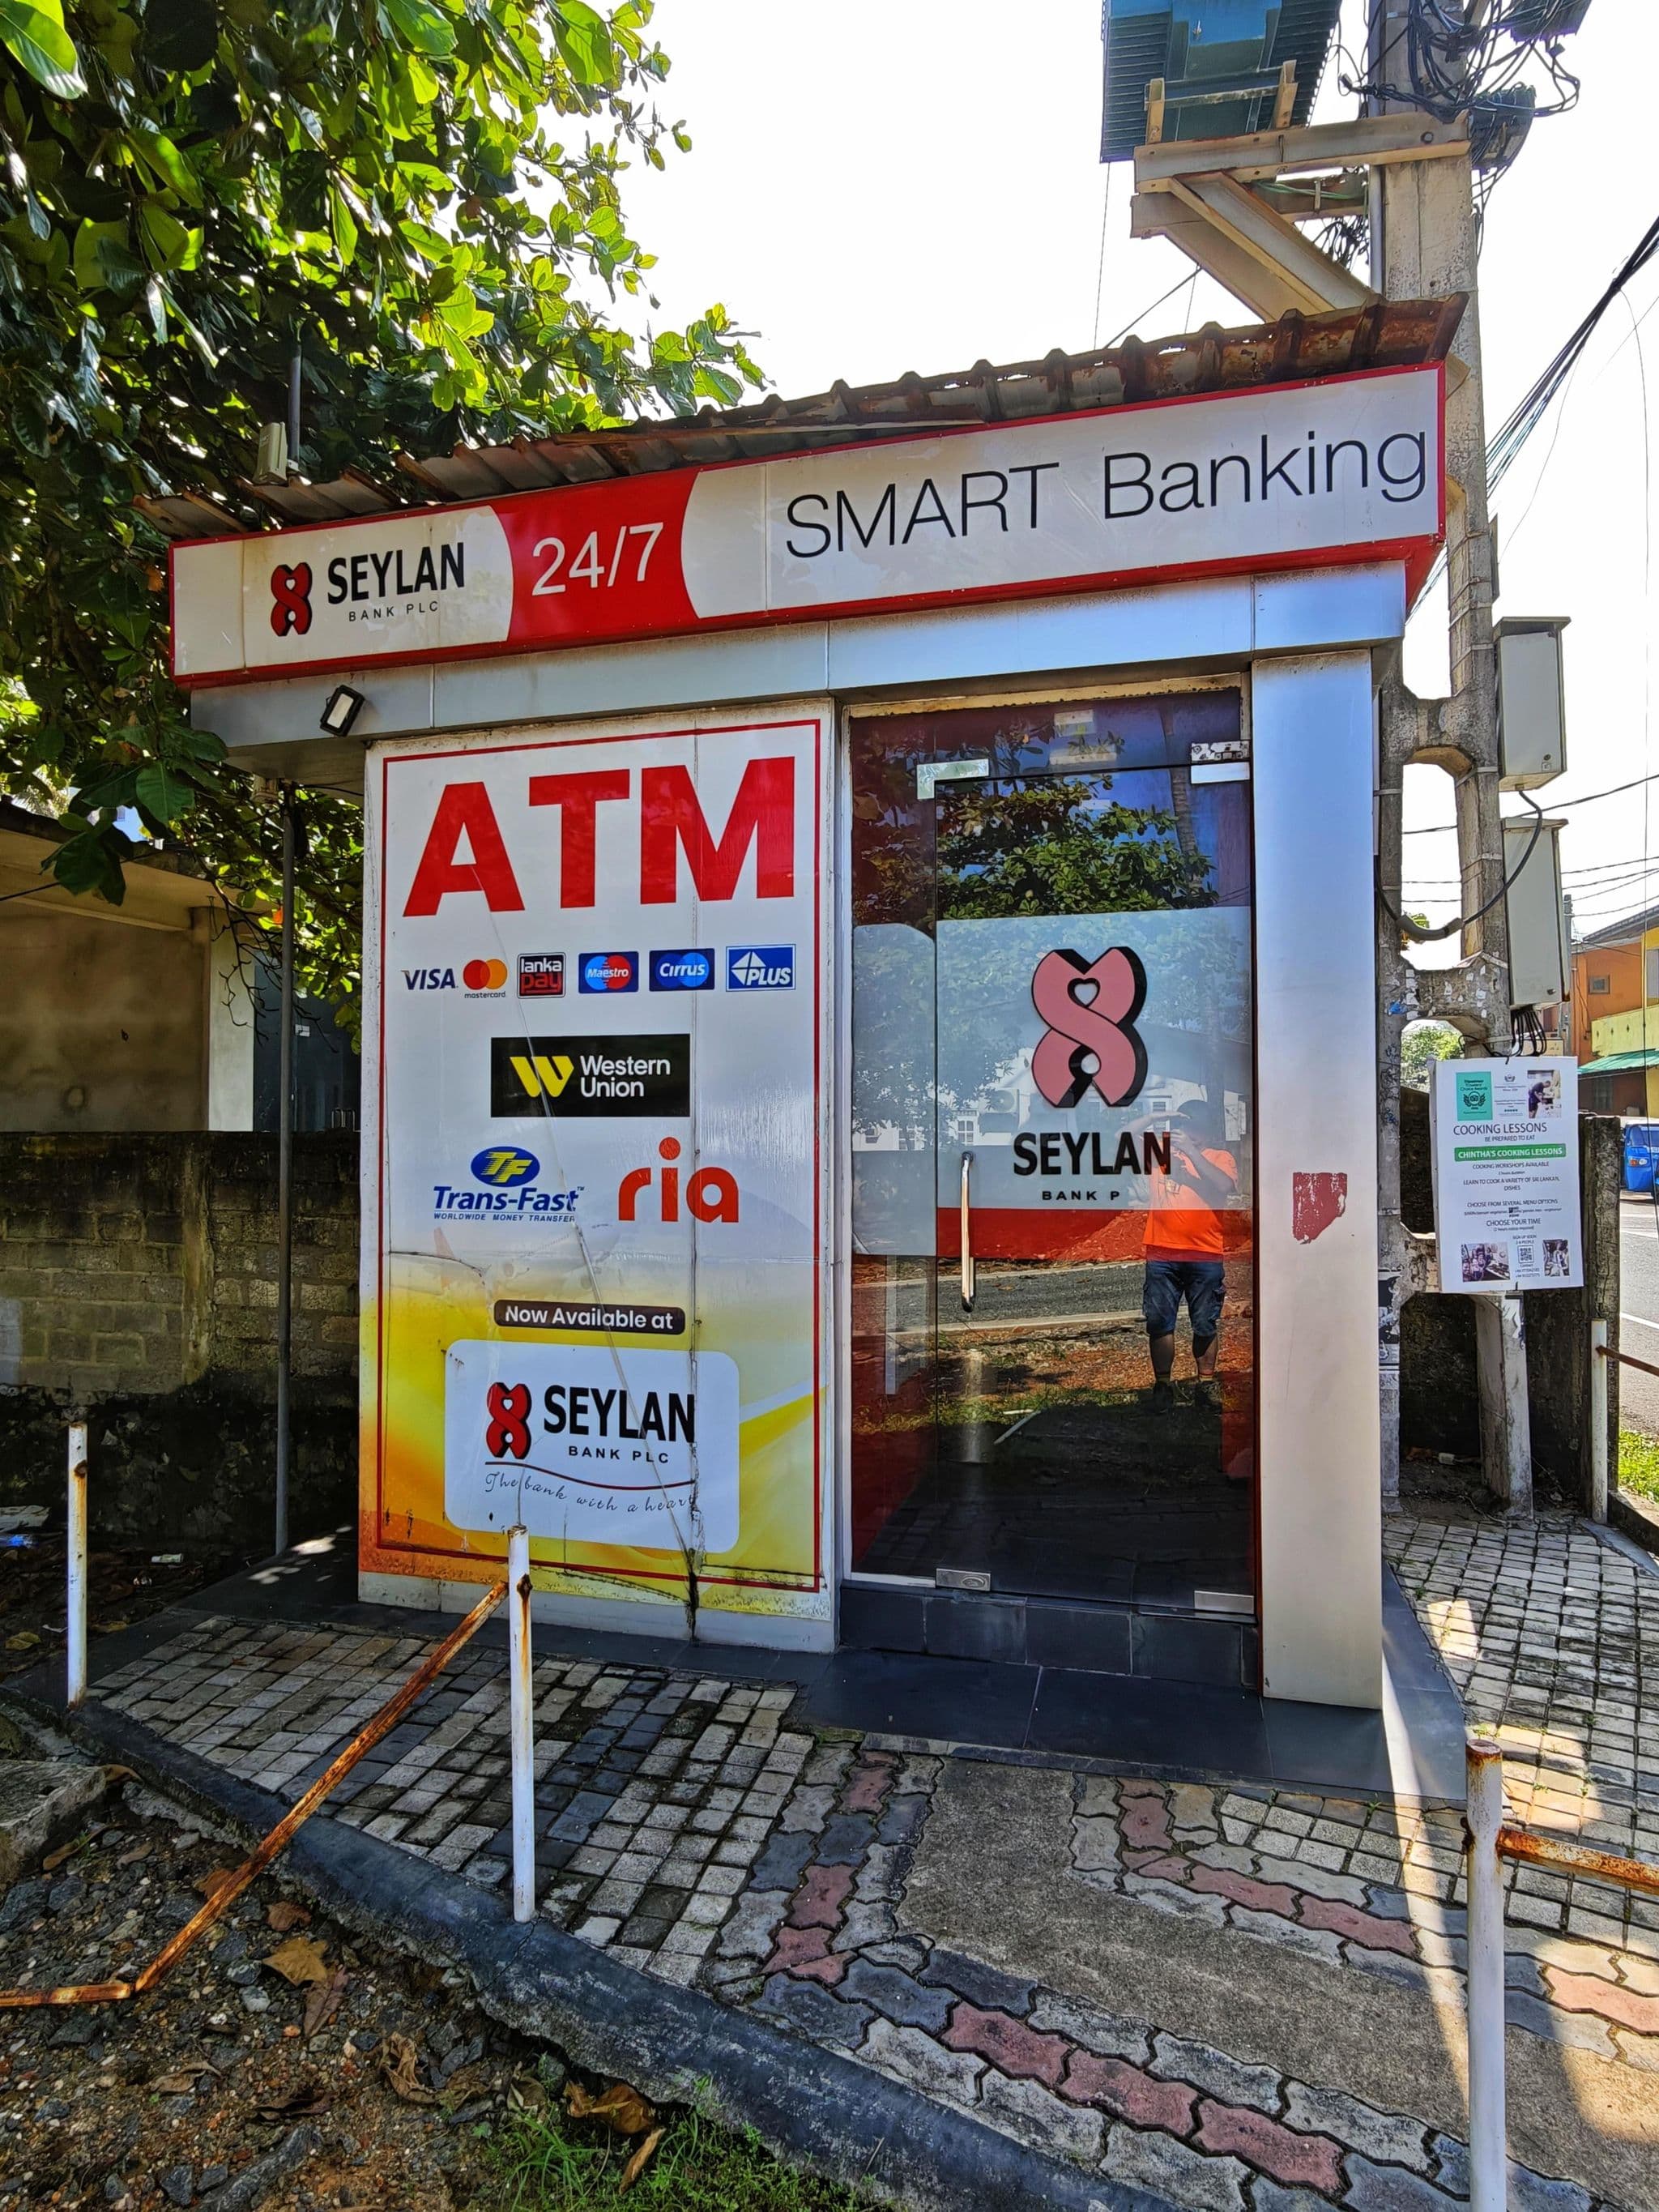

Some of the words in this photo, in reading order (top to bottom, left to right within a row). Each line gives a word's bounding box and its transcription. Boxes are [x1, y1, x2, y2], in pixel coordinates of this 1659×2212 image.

[786, 461, 1060, 559] SMART
[1103, 429, 1427, 520] Banking
[531, 521, 663, 596] 24/7
[327, 541, 465, 604] SEYLAN
[348, 605, 394, 622] BANK
[407, 600, 439, 616] PLC
[403, 756, 795, 917] ATM
[521, 958, 562, 972] lanka
[586, 967, 629, 979] Maestro
[659, 963, 706, 977] Cirrus
[402, 968, 456, 990] VISA
[521, 972, 562, 994] pay
[746, 967, 791, 986] PLUS
[464, 991, 506, 999] mastercard
[580, 1055, 671, 1076] Western
[580, 1077, 645, 1098] Union
[1453, 1124, 1501, 1136] COOKING
[1503, 1122, 1547, 1134] LESSONS
[1013, 1131, 1171, 1176] SEYLAN
[1458, 1151, 1496, 1159] CHINTHA'S
[1497, 1149, 1530, 1157] COOKING
[1531, 1147, 1563, 1155] LESSONS
[481, 1151, 533, 1184] TF
[618, 1137, 739, 1223] ria
[433, 1186, 579, 1212] Trans-Fast
[1042, 1189, 1098, 1201] BANK
[529, 1215, 575, 1223] TRANSFER
[505, 1305, 548, 1324] Now
[552, 1308, 646, 1329] Available
[650, 1313, 673, 1330] at
[544, 1384, 696, 1444] SEYLAN
[568, 1445, 620, 1460] BANK
[632, 1450, 669, 1463] PLC
[484, 1471, 518, 1492] The
[524, 1475, 567, 1500] bank
[576, 1496, 618, 1511] with
[627, 1504, 638, 1512] a
[645, 1494, 697, 1511] heart
